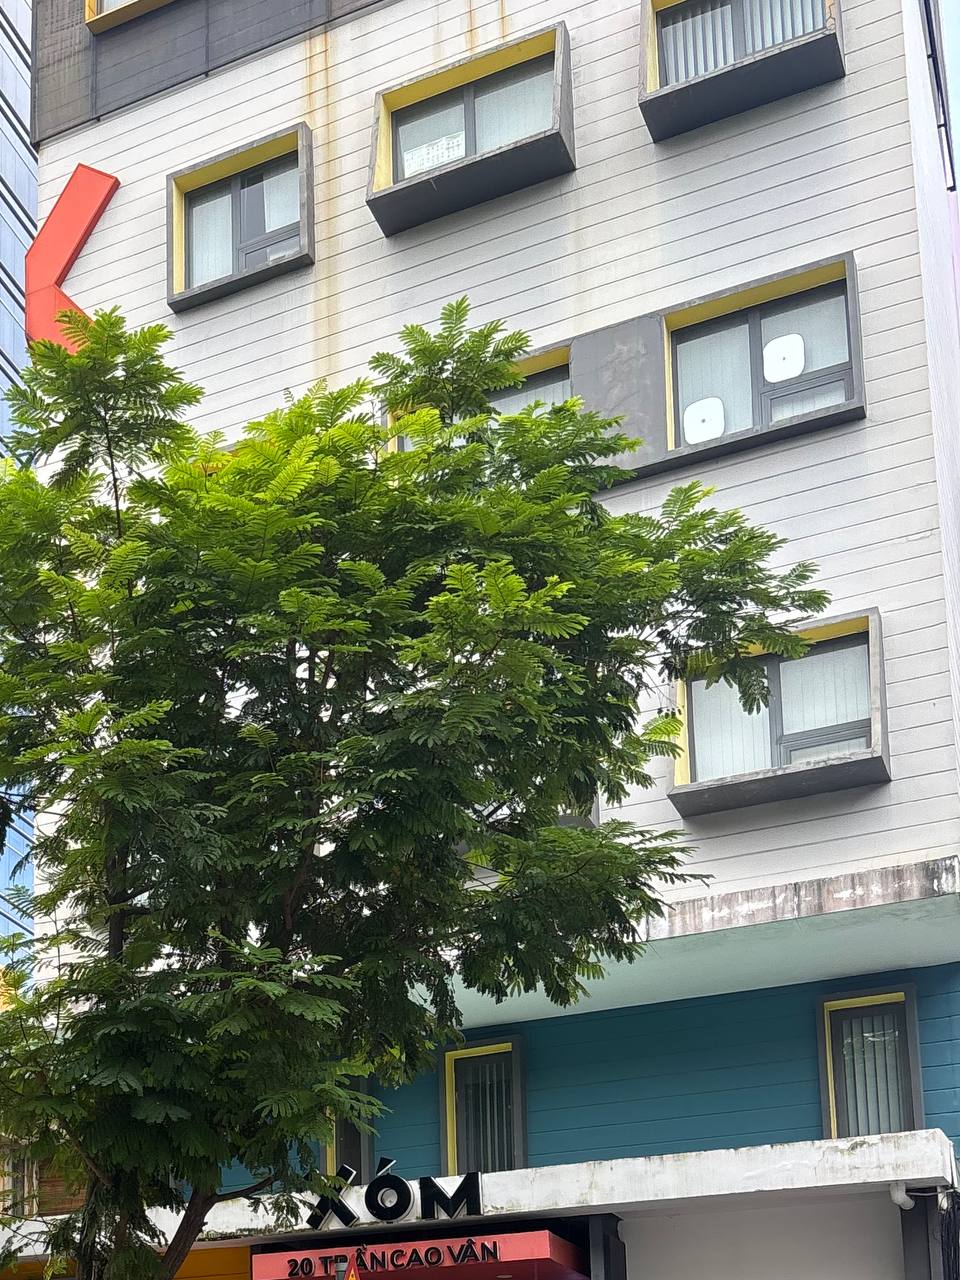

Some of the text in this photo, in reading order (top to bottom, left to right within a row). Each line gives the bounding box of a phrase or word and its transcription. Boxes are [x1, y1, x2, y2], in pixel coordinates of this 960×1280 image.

[306, 1156, 483, 1230] XÓM
[287, 1256, 315, 1278] 20
[390, 1246, 442, 1269] CAO
[448, 1238, 500, 1264] VÂN
